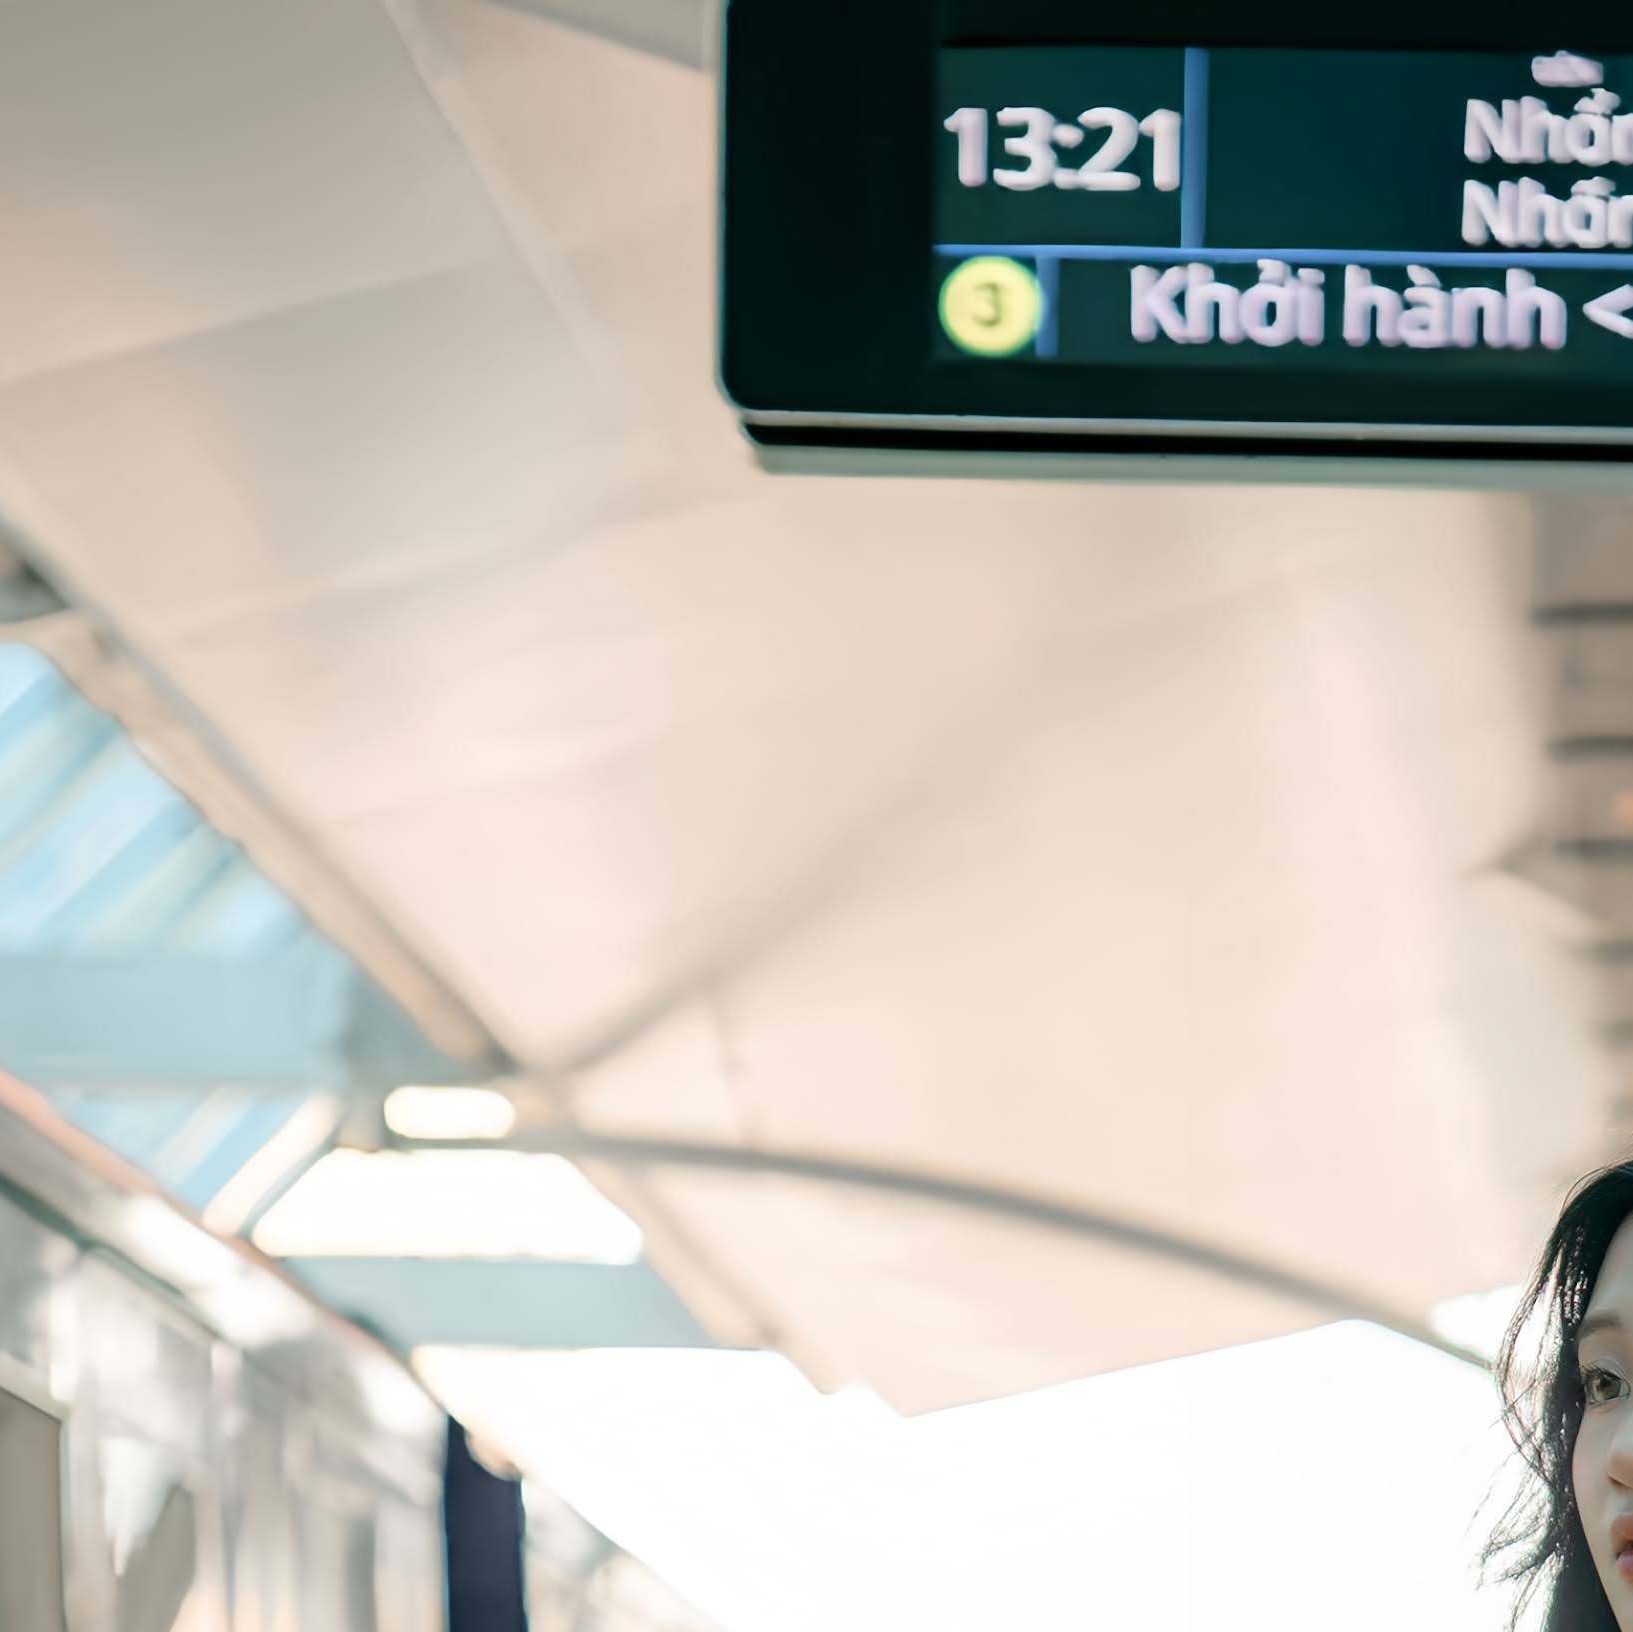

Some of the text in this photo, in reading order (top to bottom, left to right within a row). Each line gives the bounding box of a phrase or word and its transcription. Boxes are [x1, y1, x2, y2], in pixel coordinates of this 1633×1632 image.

[943, 106, 1182, 192] 13:21
[971, 281, 1003, 328] 3
[1130, 258, 1326, 347] Khởi
[1342, 264, 1567, 350] hành
